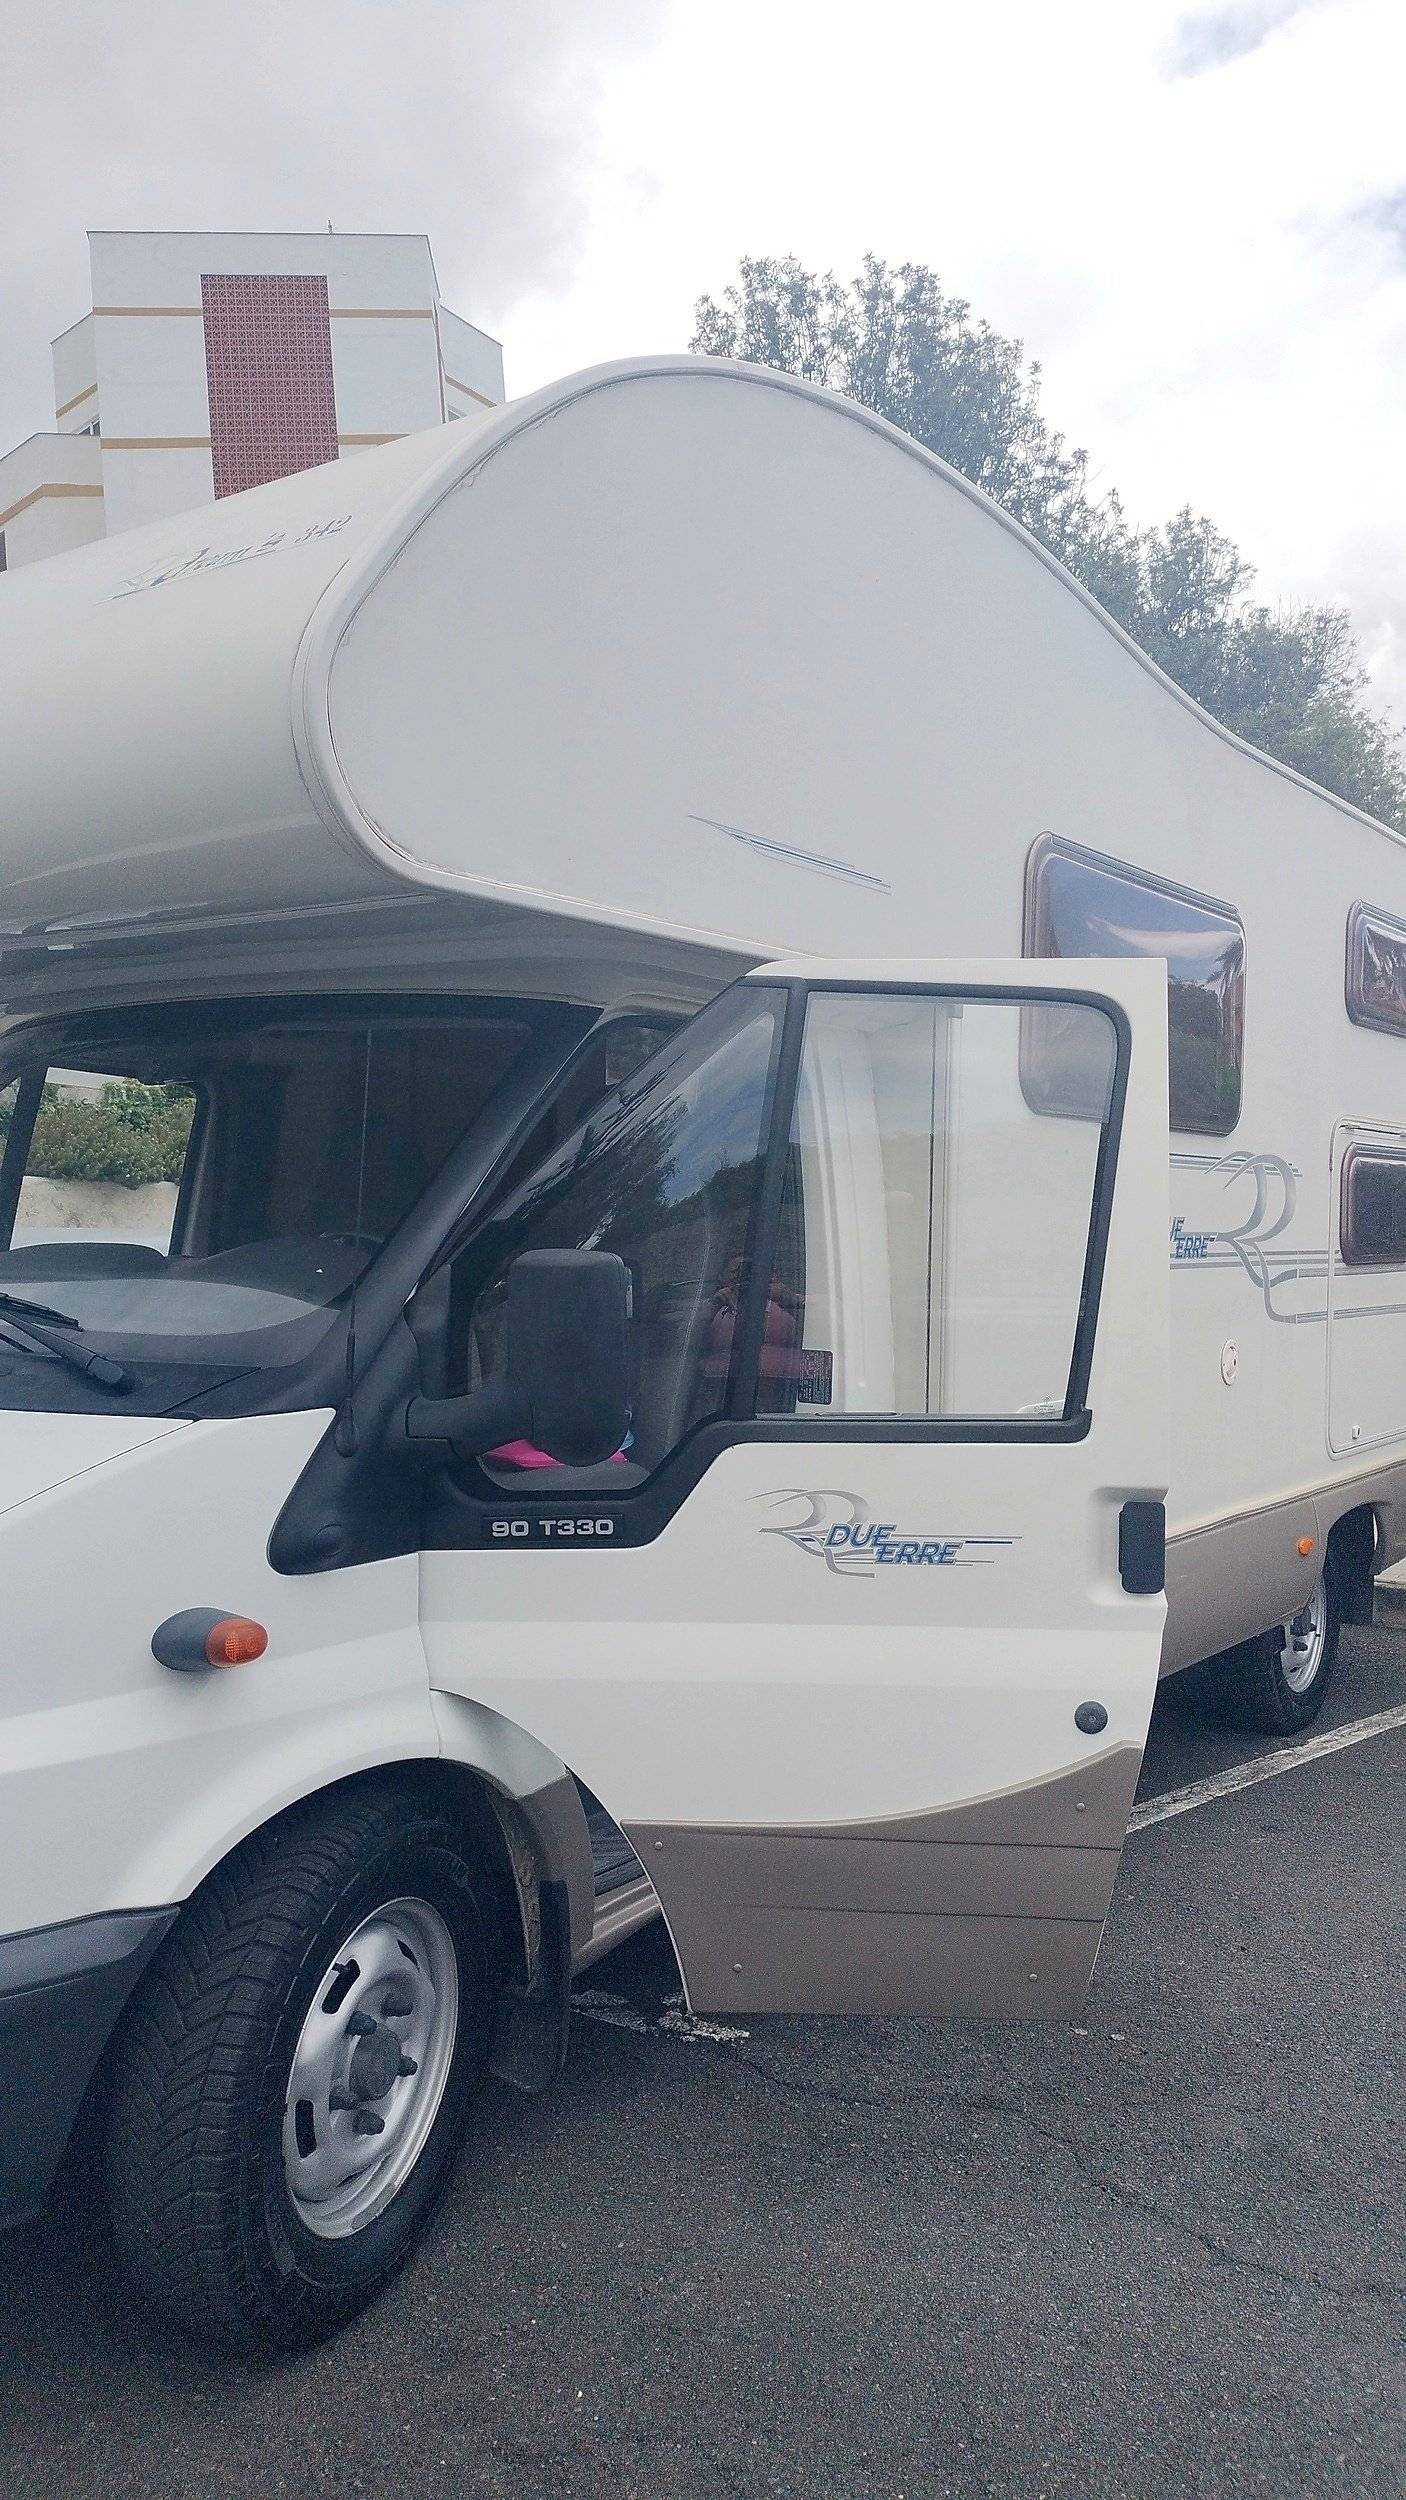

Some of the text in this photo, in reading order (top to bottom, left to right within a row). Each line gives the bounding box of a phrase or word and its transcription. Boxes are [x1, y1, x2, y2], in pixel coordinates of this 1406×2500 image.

[492, 1519, 614, 1537] 90 T330
[824, 1523, 897, 1548] DUE
[874, 1541, 964, 1566] ERRE
